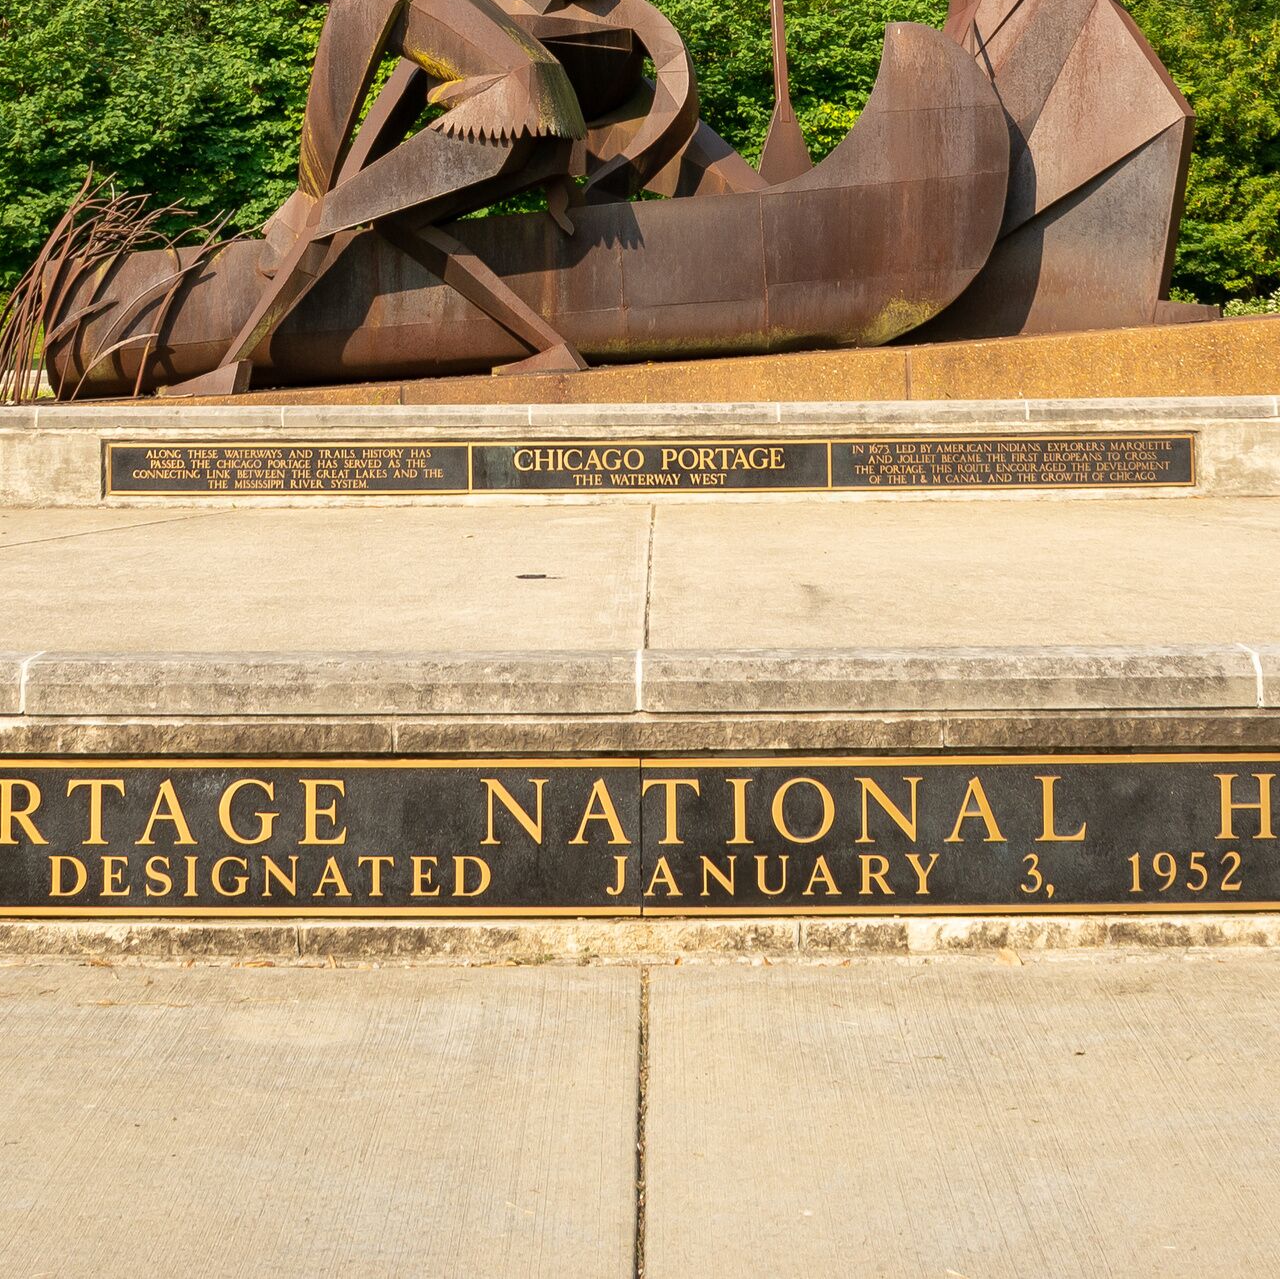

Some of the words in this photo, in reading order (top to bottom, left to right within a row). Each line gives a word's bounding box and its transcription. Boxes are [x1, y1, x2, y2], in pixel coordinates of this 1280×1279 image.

[852, 445, 864, 453] IN
[896, 445, 915, 453] LED
[921, 445, 932, 453] BY
[936, 444, 992, 452] AMERICAN
[1047, 442, 1105, 451] EXPLORERS
[1111, 441, 1172, 450] MARQUETTE
[146, 450, 181, 458] ALONG
[188, 450, 218, 458] THESE
[224, 450, 282, 458] WATERWAYS
[289, 450, 312, 458] AND
[363, 449, 403, 458] HISTORY
[411, 449, 431, 458] HAS
[514, 448, 644, 471] CHICAGO
[661, 448, 785, 470] PORTAGE
[868, 455, 892, 464] AND
[898, 455, 935, 463] JOLLIET
[942, 454, 981, 463] BECAME
[987, 454, 1006, 462] THE
[1012, 454, 1037, 462] FIRST
[1043, 452, 1102, 461] EUROPEANS
[1107, 452, 1120, 460] TO
[1125, 452, 1157, 460] CROSS
[191, 460, 210, 468] THE
[217, 460, 262, 468] CHICAGO
[268, 460, 311, 468] PORTAGE
[318, 460, 337, 468] HAS
[344, 460, 381, 468] SERVED
[388, 460, 400, 468] AS
[406, 459, 426, 468] THE
[855, 465, 873, 474] THE
[931, 465, 952, 473] THIS
[958, 464, 990, 473] ROUTE
[997, 463, 1066, 472] ENCOURAGED
[1071, 463, 1091, 471] THE
[1097, 462, 1170, 471] DEVELOPMENT
[133, 470, 200, 479] CONNECTING
[207, 470, 230, 478] LINK
[237, 470, 285, 478] BETWEEN
[292, 470, 311, 478] THE
[316, 470, 349, 478] GREAT
[356, 470, 387, 478] LAKES
[394, 470, 417, 478] AND
[424, 470, 443, 478] THE
[573, 474, 602, 486] THE
[611, 474, 681, 485] WATERWAY
[690, 473, 726, 485] WEST
[869, 475, 882, 484] OF
[887, 475, 907, 484] THE
[912, 475, 915, 483] I
[921, 475, 927, 483] &
[933, 475, 941, 483] M
[946, 474, 982, 483] CANAL
[988, 474, 1012, 483] AND
[1018, 474, 1037, 482] THE
[1041, 473, 1087, 482] GROWTH
[1092, 473, 1104, 481] OF
[208, 480, 228, 488] THE
[235, 480, 284, 488] MISSISSIPPI
[290, 480, 324, 488] RIVER
[331, 480, 368, 488] SYSTEM.
[480, 775, 1088, 847] NATIONAL
[48, 855, 492, 899] DESIGNATED
[605, 852, 941, 897] JANUARY
[1020, 852, 1057, 900] 3,
[1127, 851, 1244, 893] 1952
